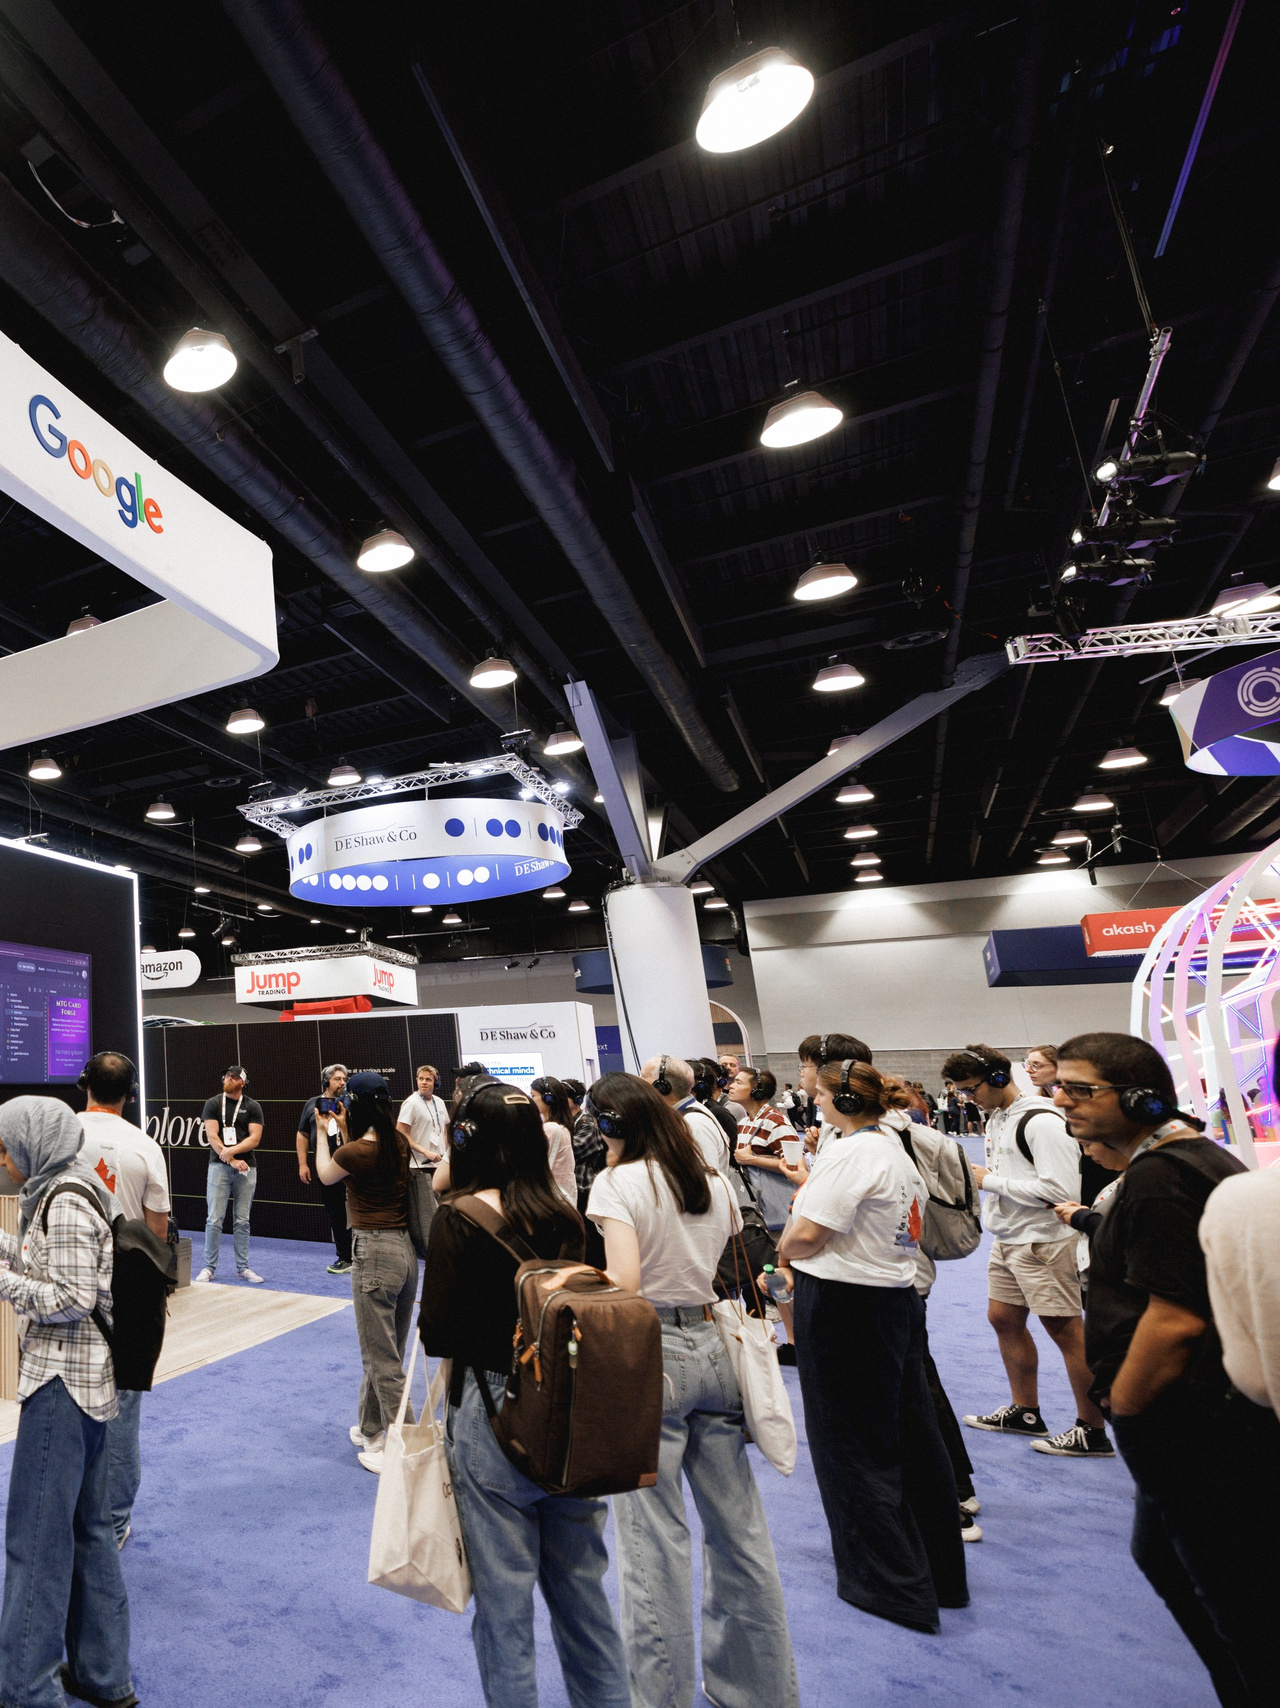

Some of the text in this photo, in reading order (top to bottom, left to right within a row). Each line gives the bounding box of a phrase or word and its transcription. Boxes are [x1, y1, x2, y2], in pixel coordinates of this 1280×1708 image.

[29, 394, 164, 534] Google
[354, 835, 385, 848] Shaw
[386, 831, 397, 843] &
[399, 830, 417, 841] Co
[1102, 922, 1156, 937] akash
[141, 960, 182, 973] amazon
[246, 971, 300, 994] Jump
[373, 963, 394, 993] Jump
[258, 988, 286, 996] TRADING
[500, 1030, 527, 1040] Shaw
[530, 1029, 538, 1039] &
[540, 1028, 556, 1039] Co
[513, 1067, 535, 1075] minds
[146, 1107, 210, 1147] plore
